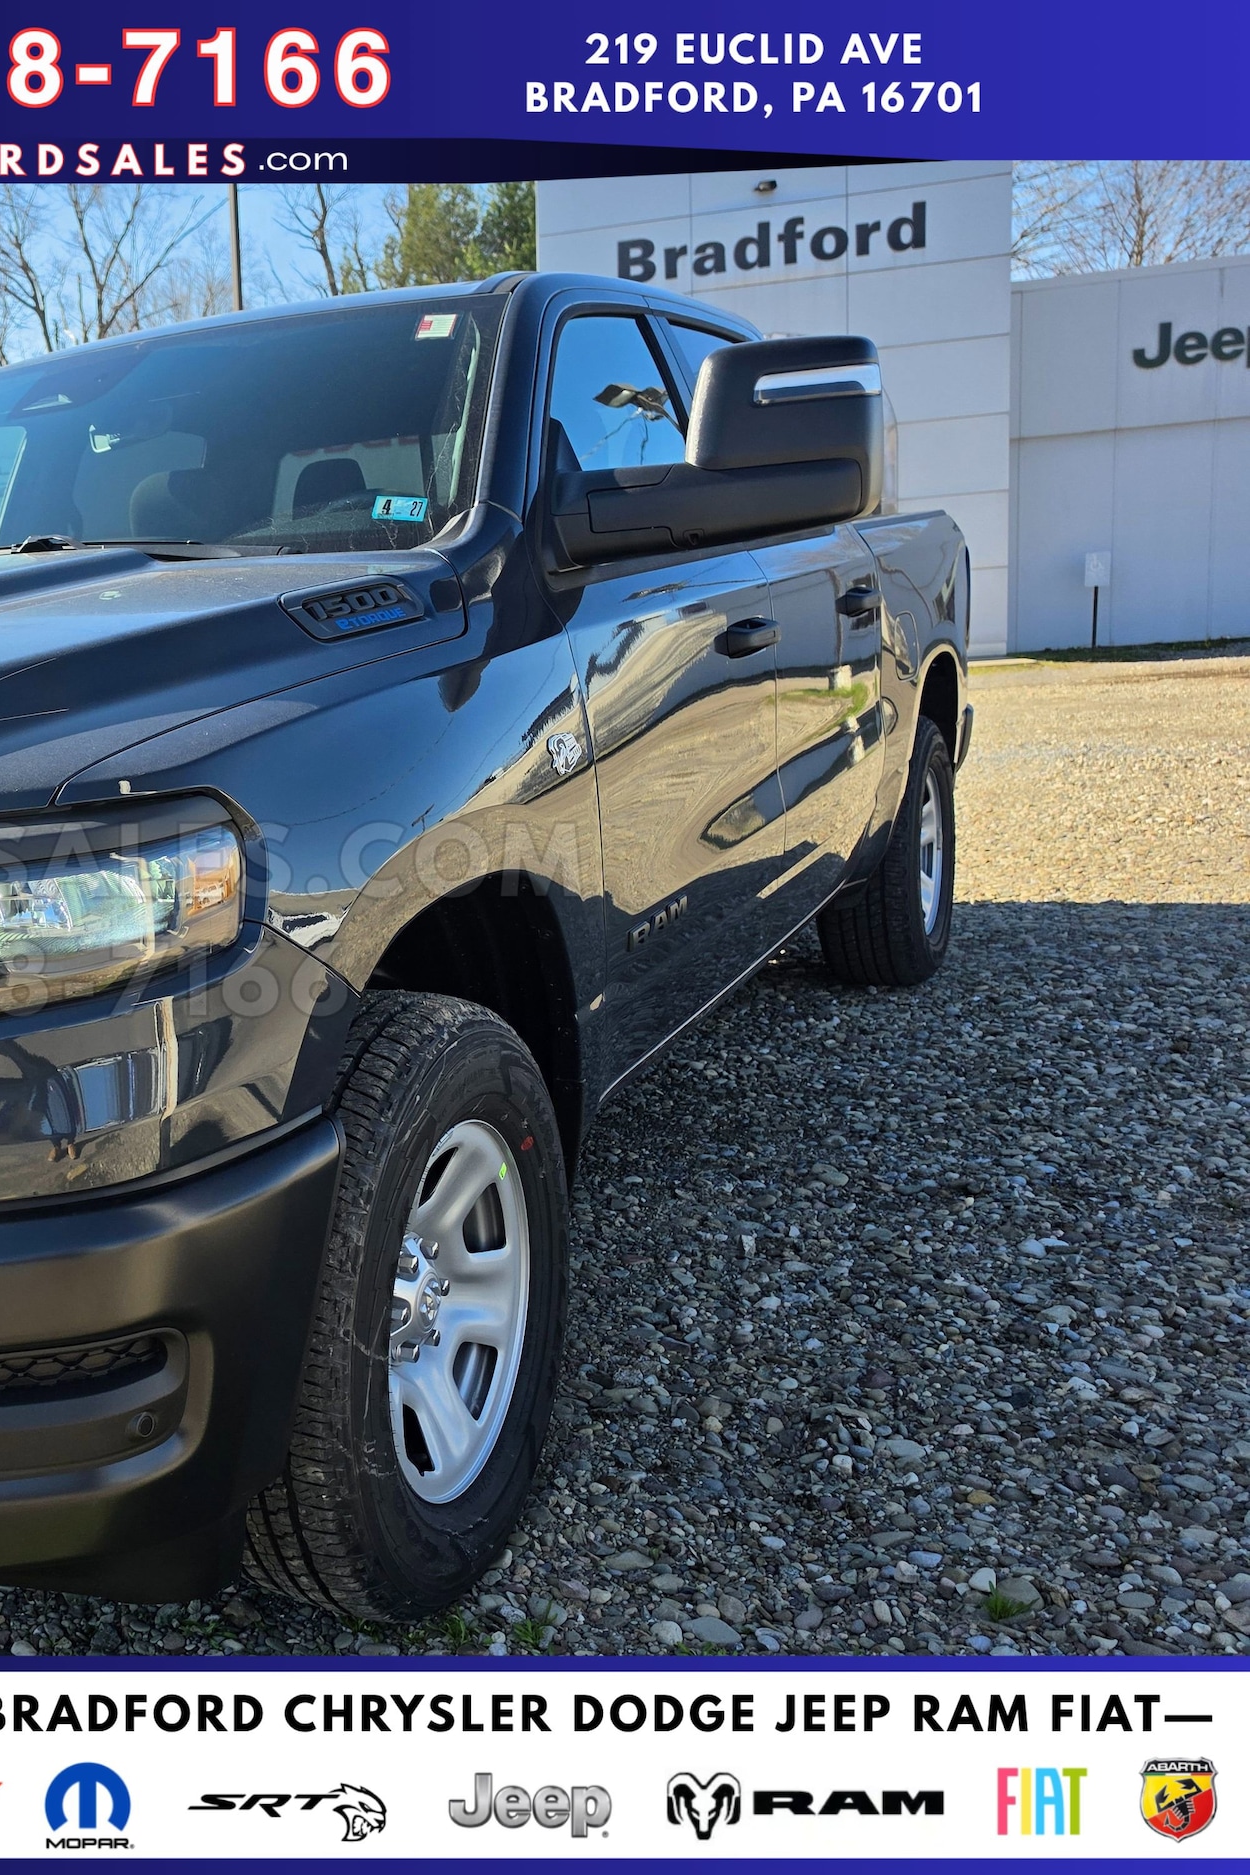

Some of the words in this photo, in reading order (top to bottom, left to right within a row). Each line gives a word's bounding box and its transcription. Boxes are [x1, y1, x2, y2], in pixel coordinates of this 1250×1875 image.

[616, 201, 928, 283] Bradford
[1133, 321, 1250, 369] Jee
[381, 498, 392, 515] 4
[409, 500, 424, 517] 27
[302, 585, 398, 621] 1500
[627, 895, 688, 952] RAM
